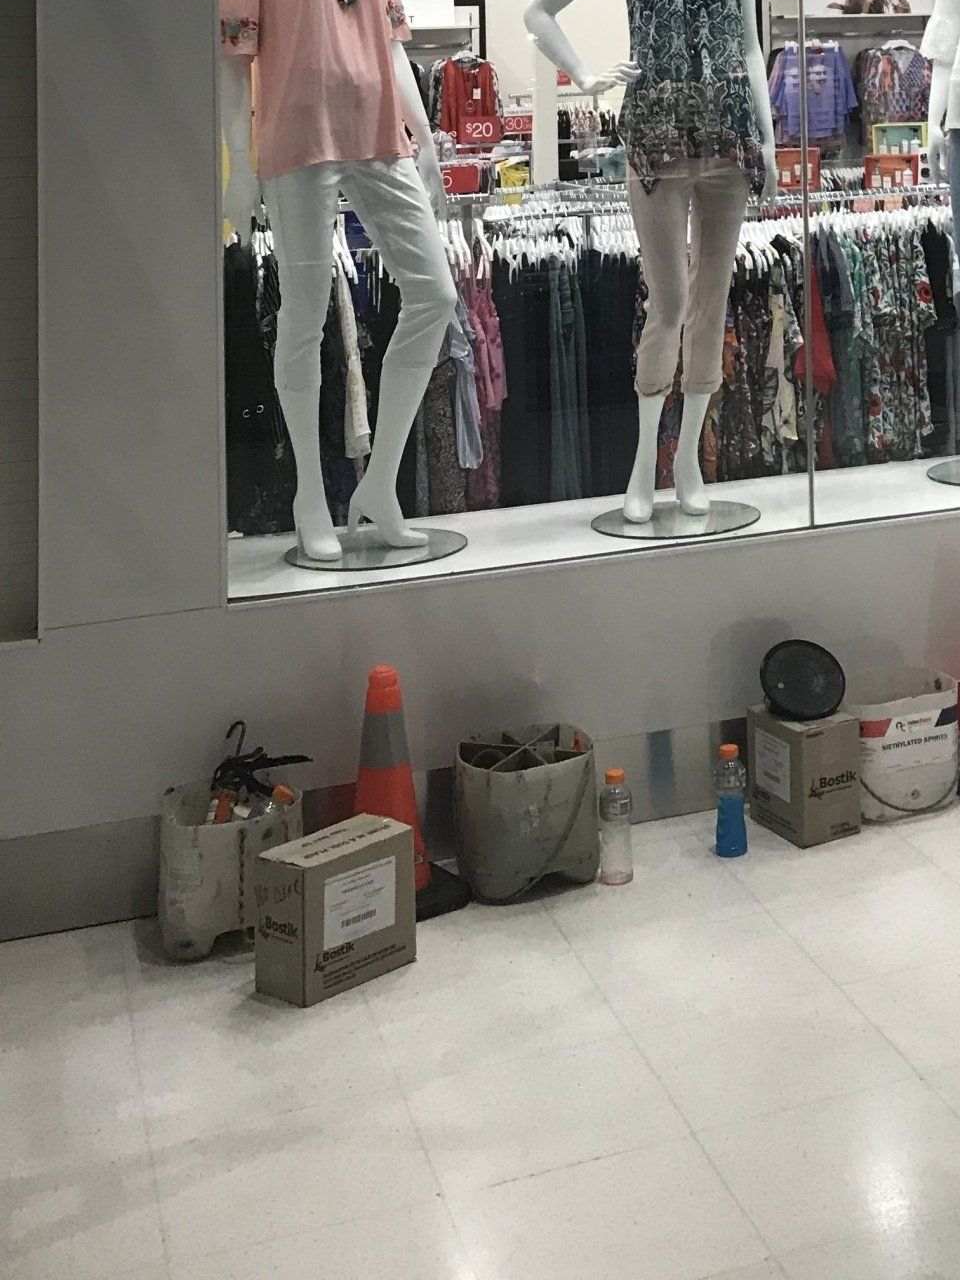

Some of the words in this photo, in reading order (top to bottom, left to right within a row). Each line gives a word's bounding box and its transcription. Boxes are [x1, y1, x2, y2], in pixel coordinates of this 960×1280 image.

[465, 122, 493, 138] $20
[881, 738, 923, 751] METHYLATED
[820, 770, 857, 789] Bostik
[265, 915, 299, 939] Bostik
[322, 941, 355, 963] Bostik
